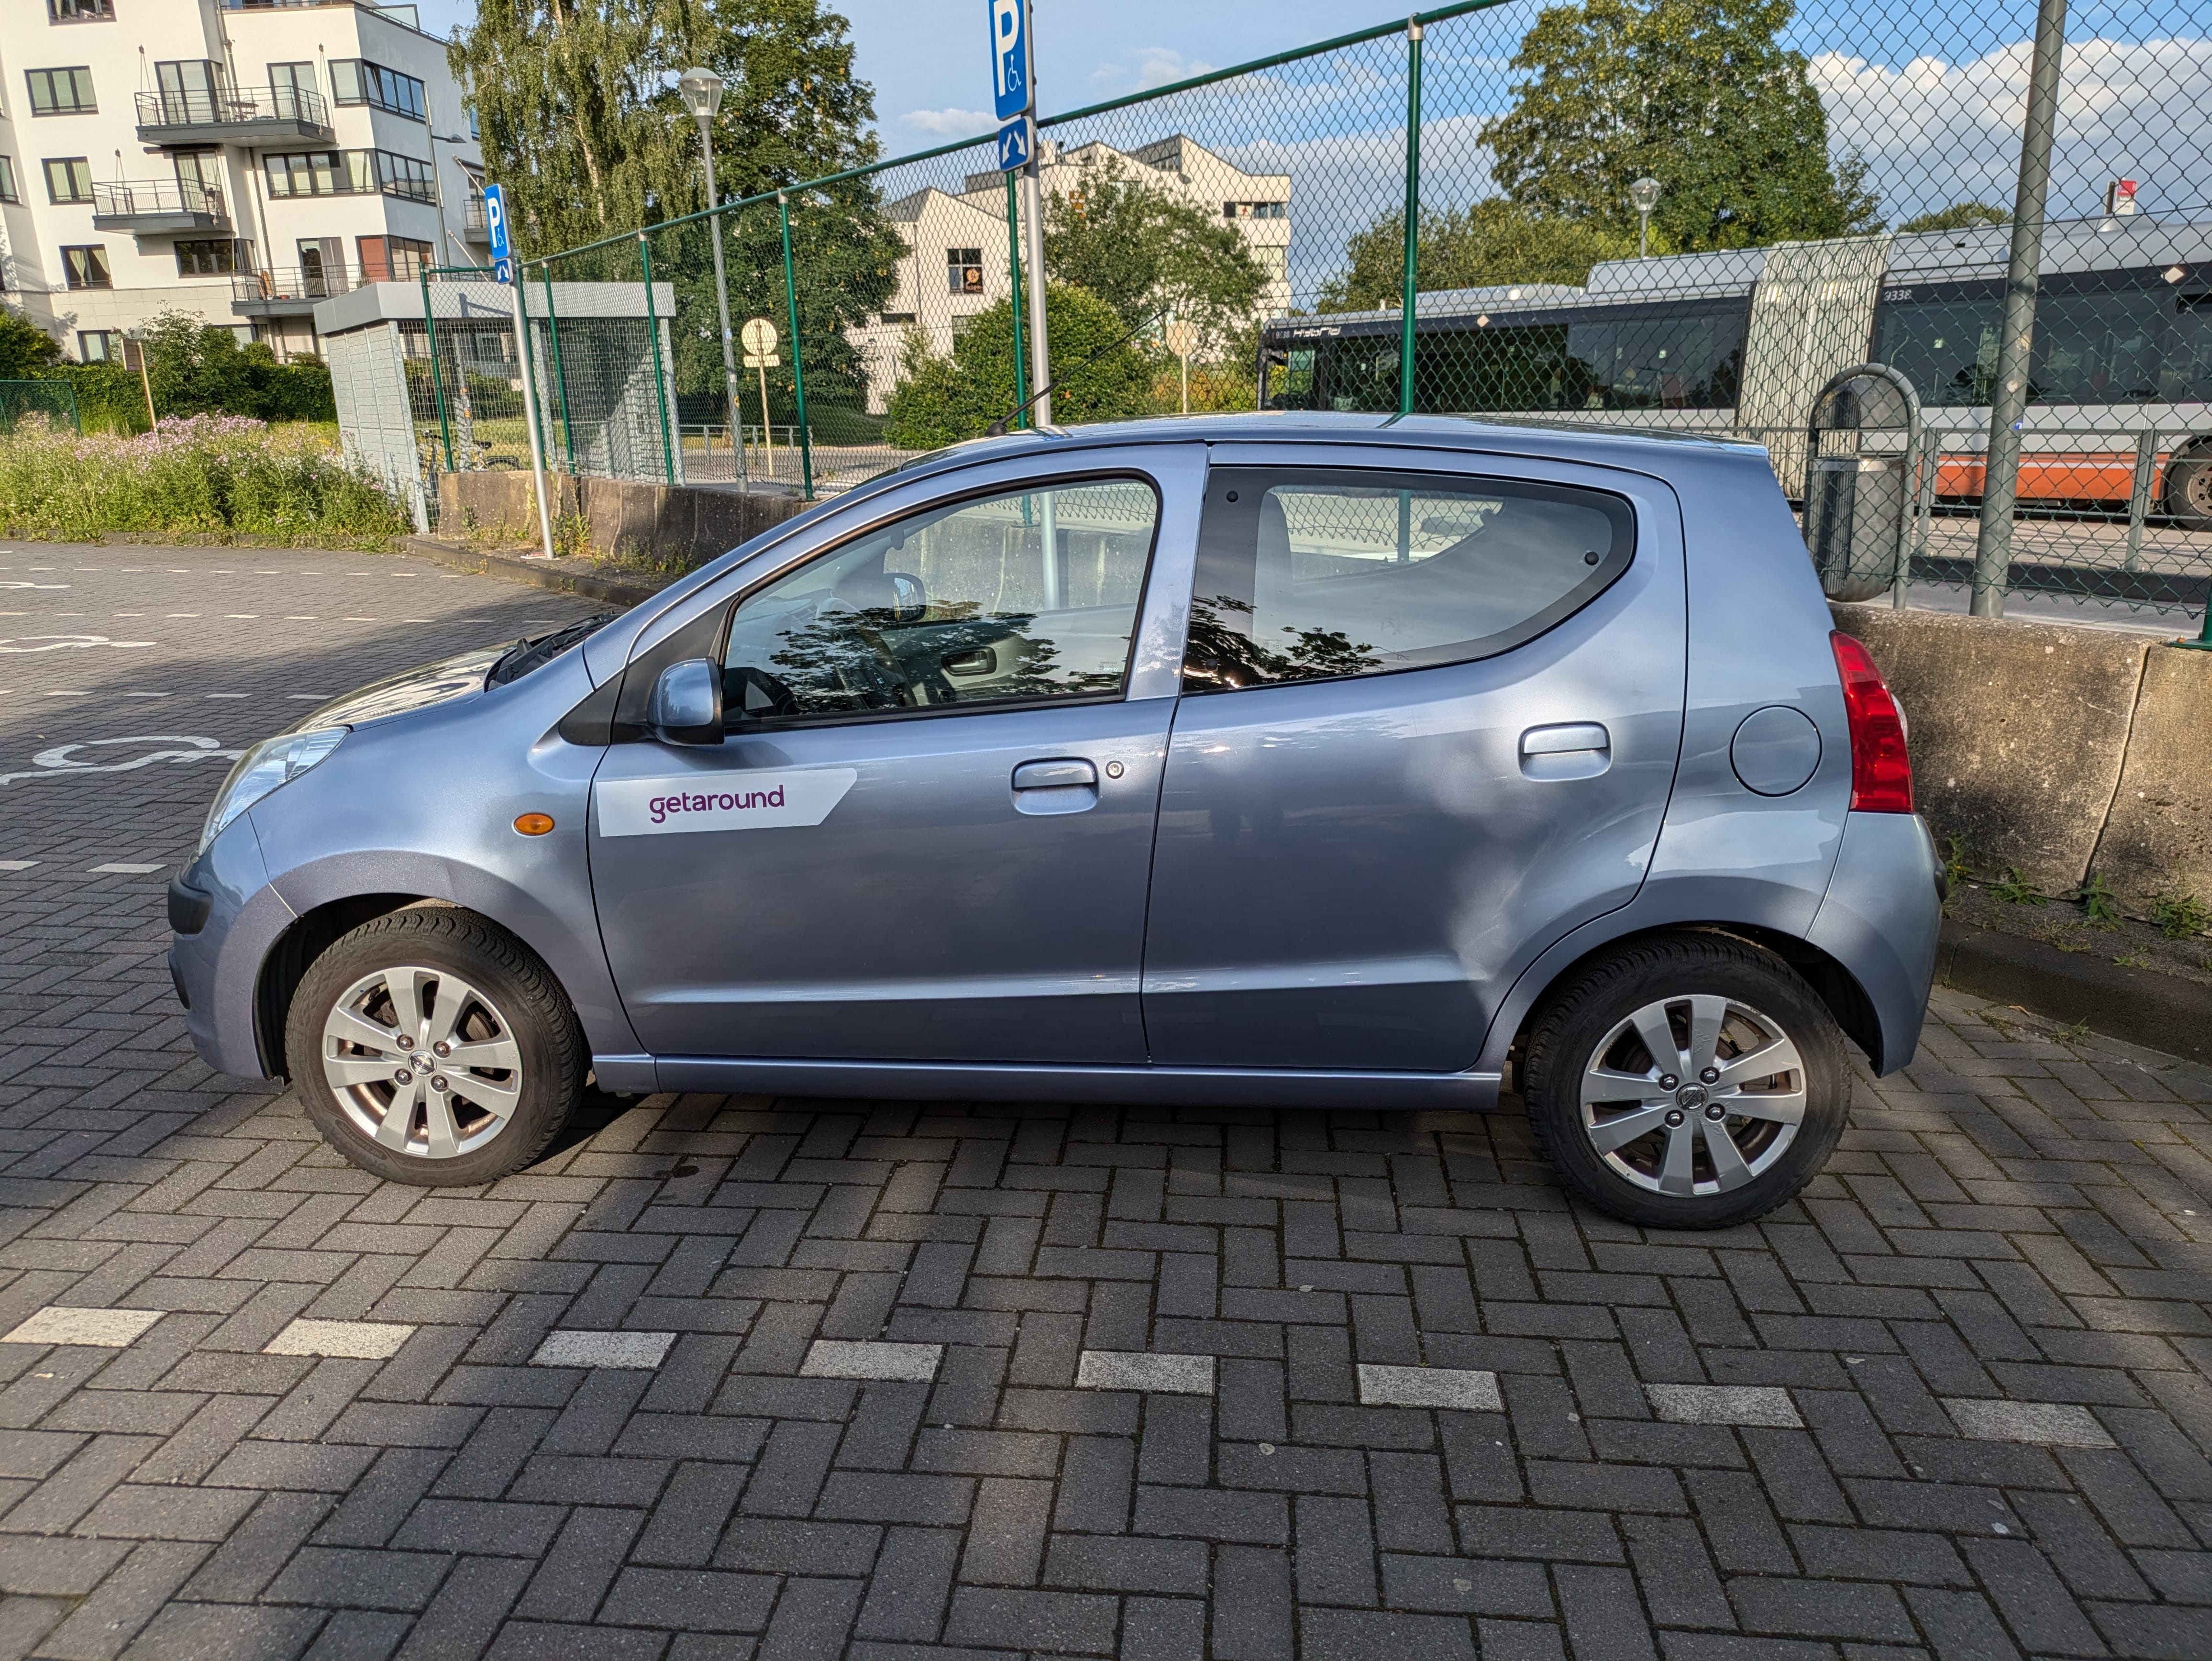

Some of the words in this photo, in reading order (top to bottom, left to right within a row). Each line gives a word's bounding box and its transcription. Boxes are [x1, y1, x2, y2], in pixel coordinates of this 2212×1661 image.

[994, 0, 1019, 97] P
[487, 198, 500, 248] P
[1883, 289, 1912, 301] 9338
[649, 784, 785, 824] getaround
[338, 1122, 354, 1138] TYRE
[355, 1138, 371, 1151] RAIN
[371, 1148, 384, 1157] THE
